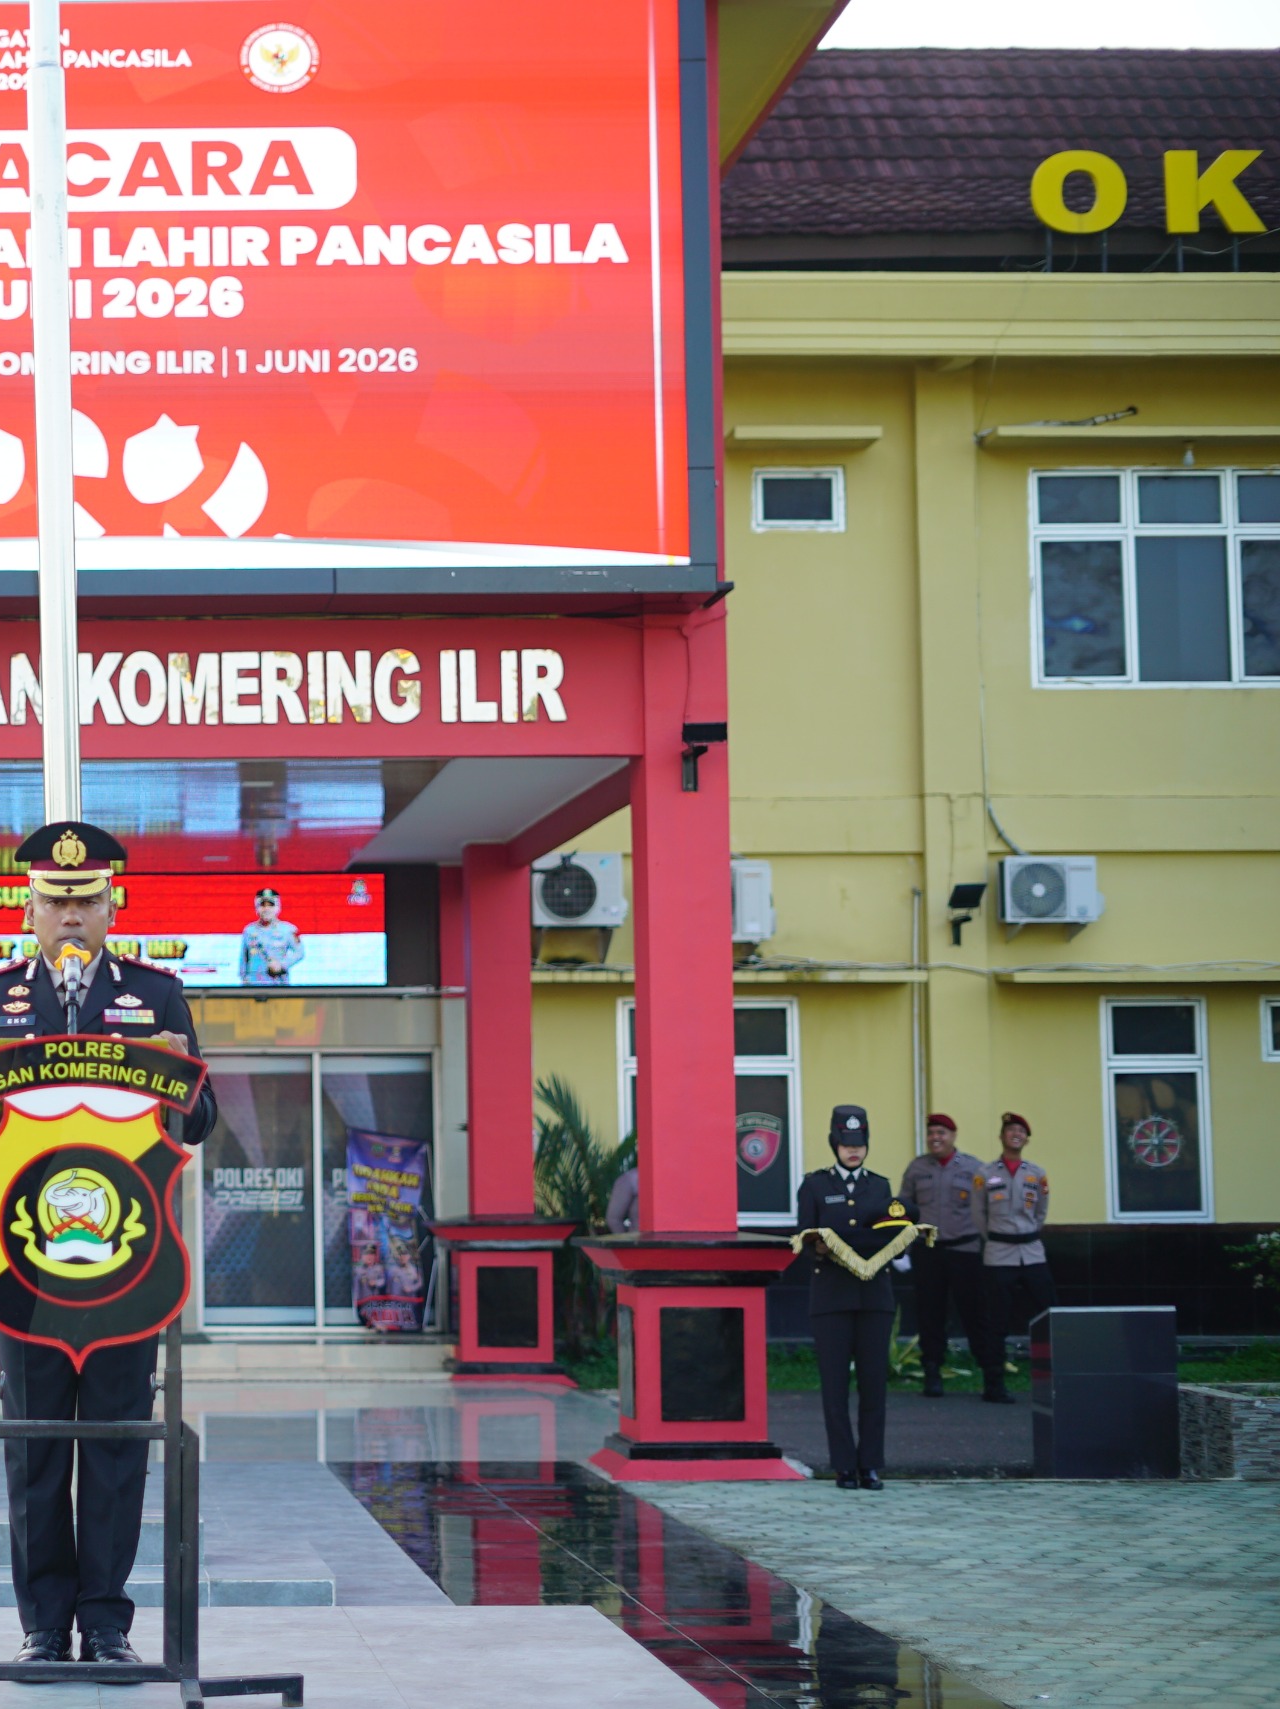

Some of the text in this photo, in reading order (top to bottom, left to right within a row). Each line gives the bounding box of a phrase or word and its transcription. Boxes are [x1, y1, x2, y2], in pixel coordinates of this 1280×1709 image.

[63, 49, 192, 68] PANCASILA
[93, 226, 270, 268] LAHIR
[280, 223, 629, 266] PANCASILA
[102, 276, 245, 318] 2026
[156, 350, 215, 375] ILIR
[235, 349, 247, 373] 1
[255, 350, 330, 374] JUNI
[337, 347, 418, 373] 2026
[78, 649, 422, 726] KOMERING
[439, 648, 568, 723] ILIR
[45, 1041, 125, 1060] POLRES
[39, 1062, 146, 1086] KOMERING
[150, 1073, 188, 1099] ILIR
[213, 1167, 304, 1189] POLRES OKI
